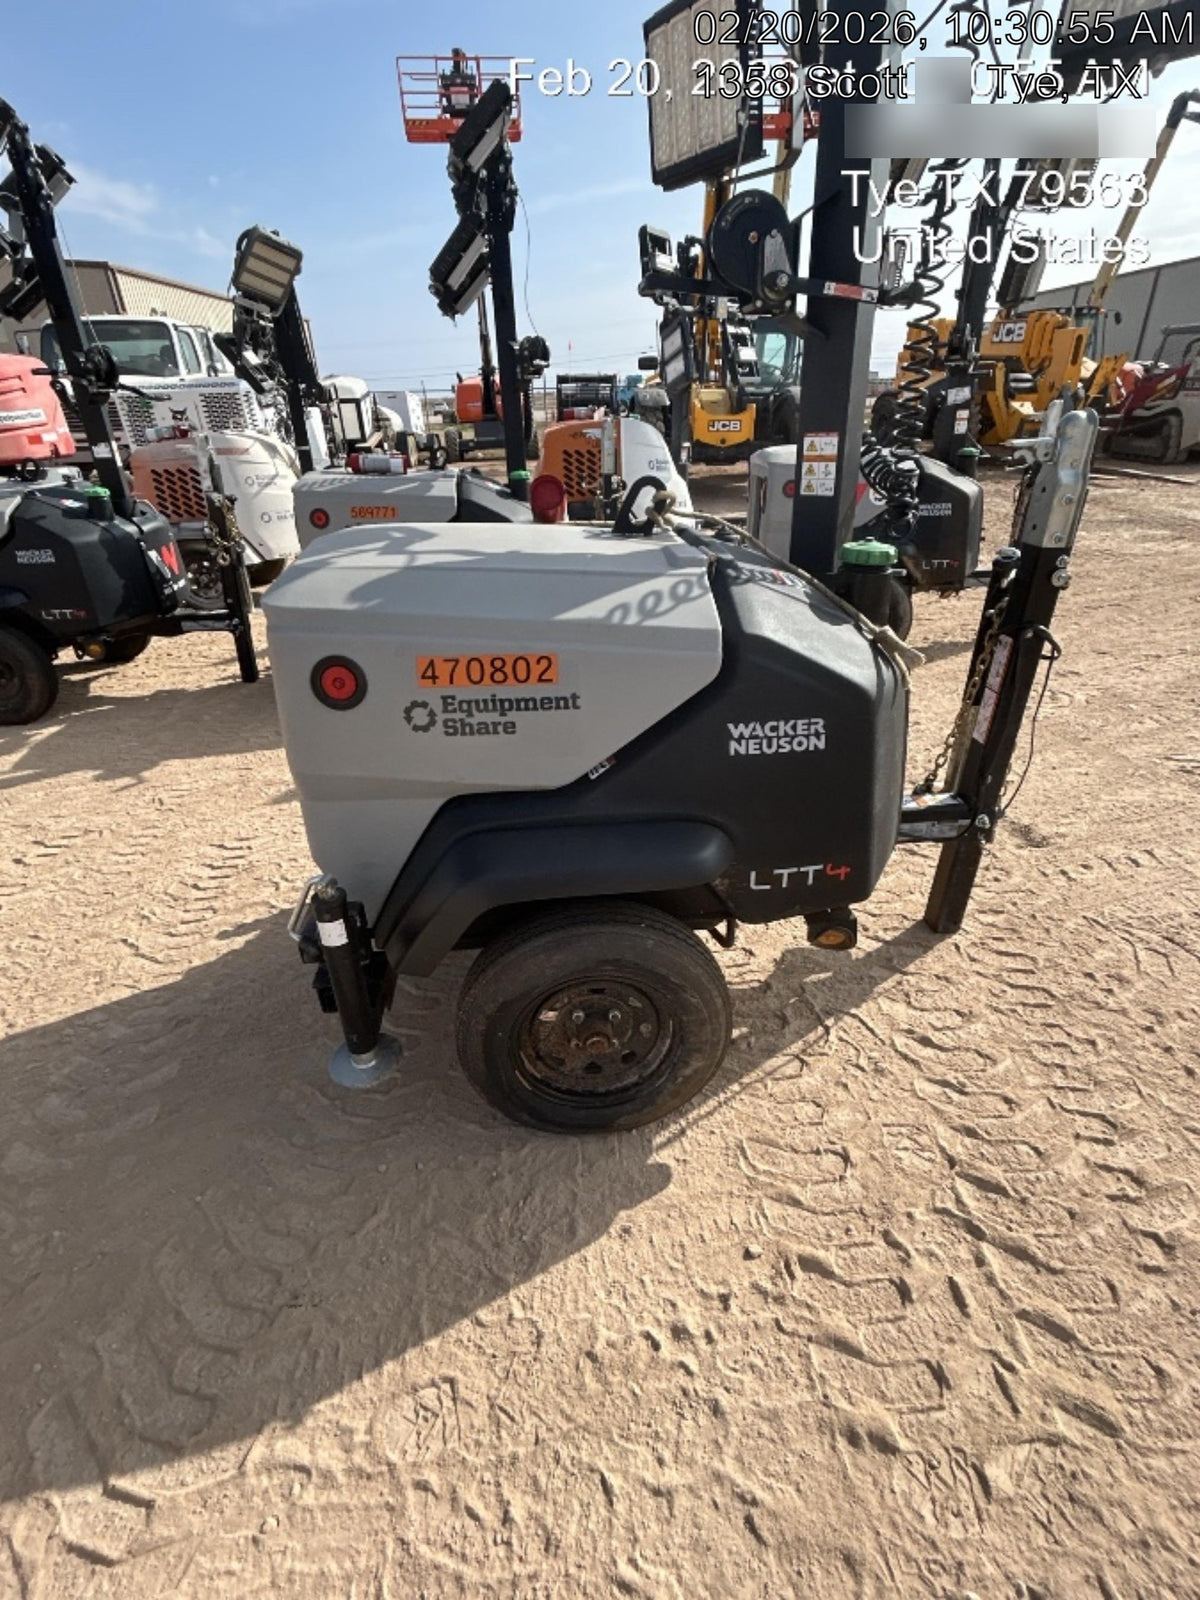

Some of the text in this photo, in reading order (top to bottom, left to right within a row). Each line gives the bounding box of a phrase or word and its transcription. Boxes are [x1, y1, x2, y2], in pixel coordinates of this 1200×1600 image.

[992, 323, 1026, 342] JCB
[708, 420, 741, 432] JCB
[420, 655, 553, 685] 470802
[440, 692, 581, 717] Equipment
[443, 717, 517, 737] Share
[727, 718, 826, 738] WACKER
[729, 734, 826, 756] NEUSON
[750, 864, 851, 890] LTT4
